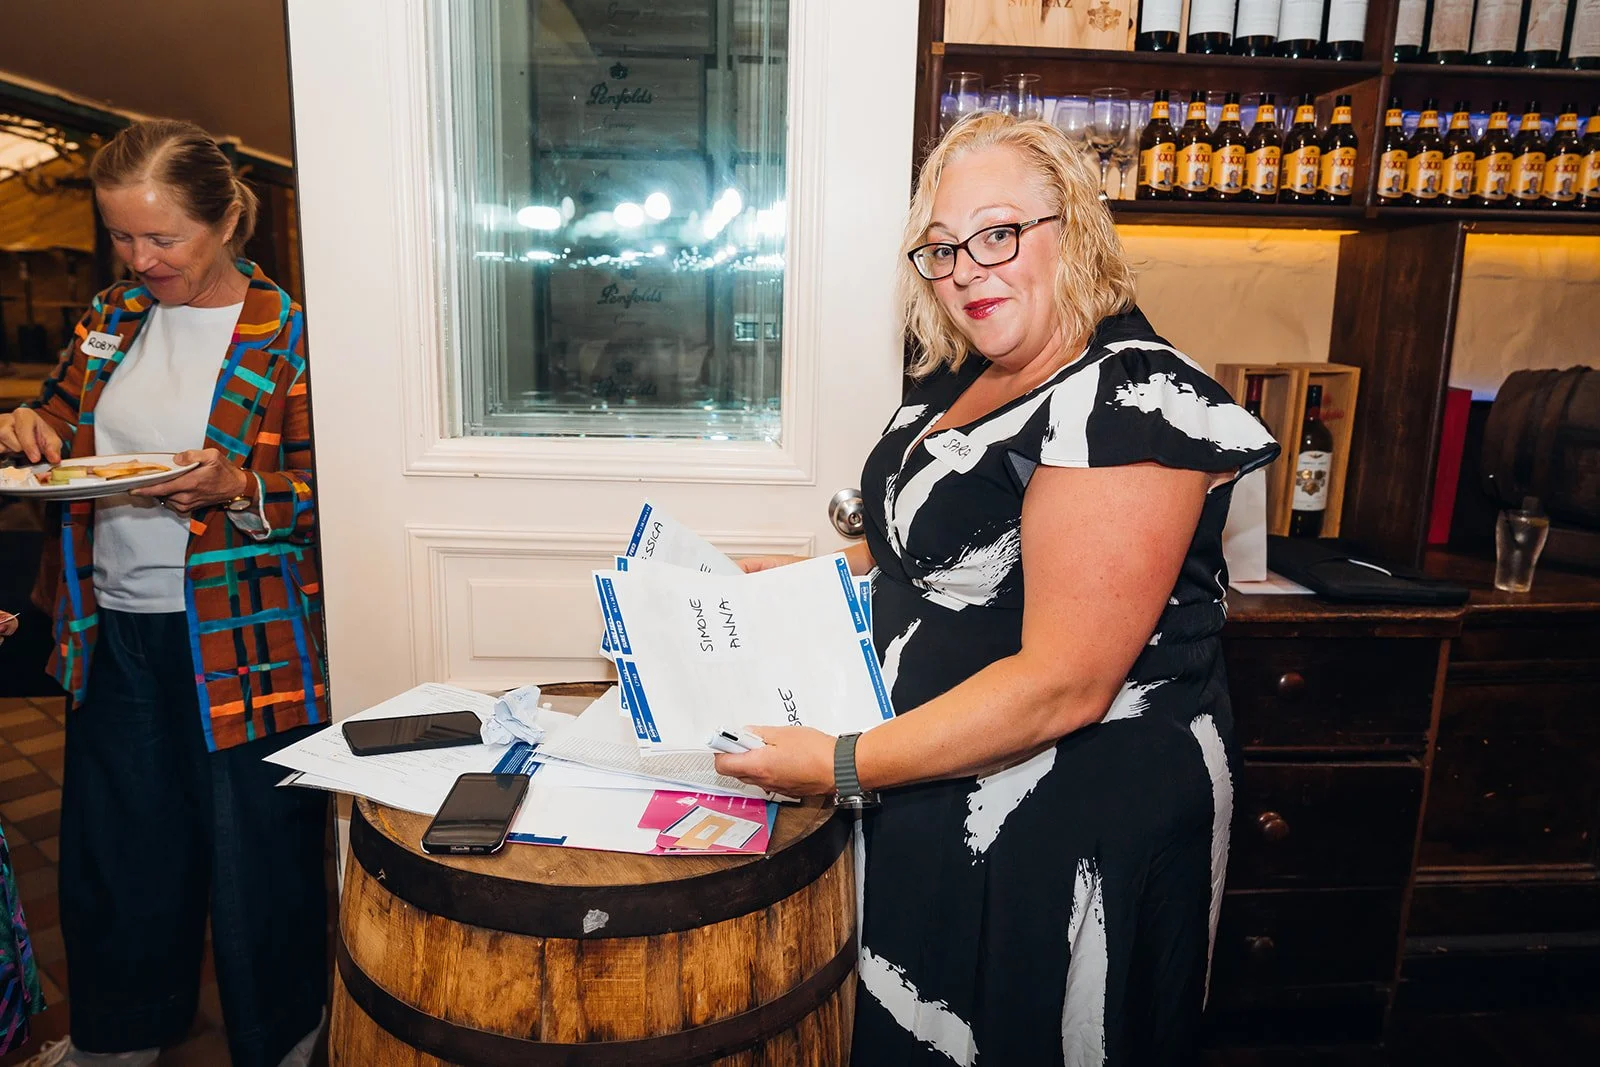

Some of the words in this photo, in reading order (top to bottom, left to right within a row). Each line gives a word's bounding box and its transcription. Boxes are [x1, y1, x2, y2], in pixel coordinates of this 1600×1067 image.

[586, 81, 652, 111] Penfolds
[597, 283, 662, 309] Penfolds
[942, 438, 971, 460] SARA
[641, 521, 663, 560] SSICA
[688, 598, 713, 652] SIMONE
[718, 597, 741, 648] ANNA
